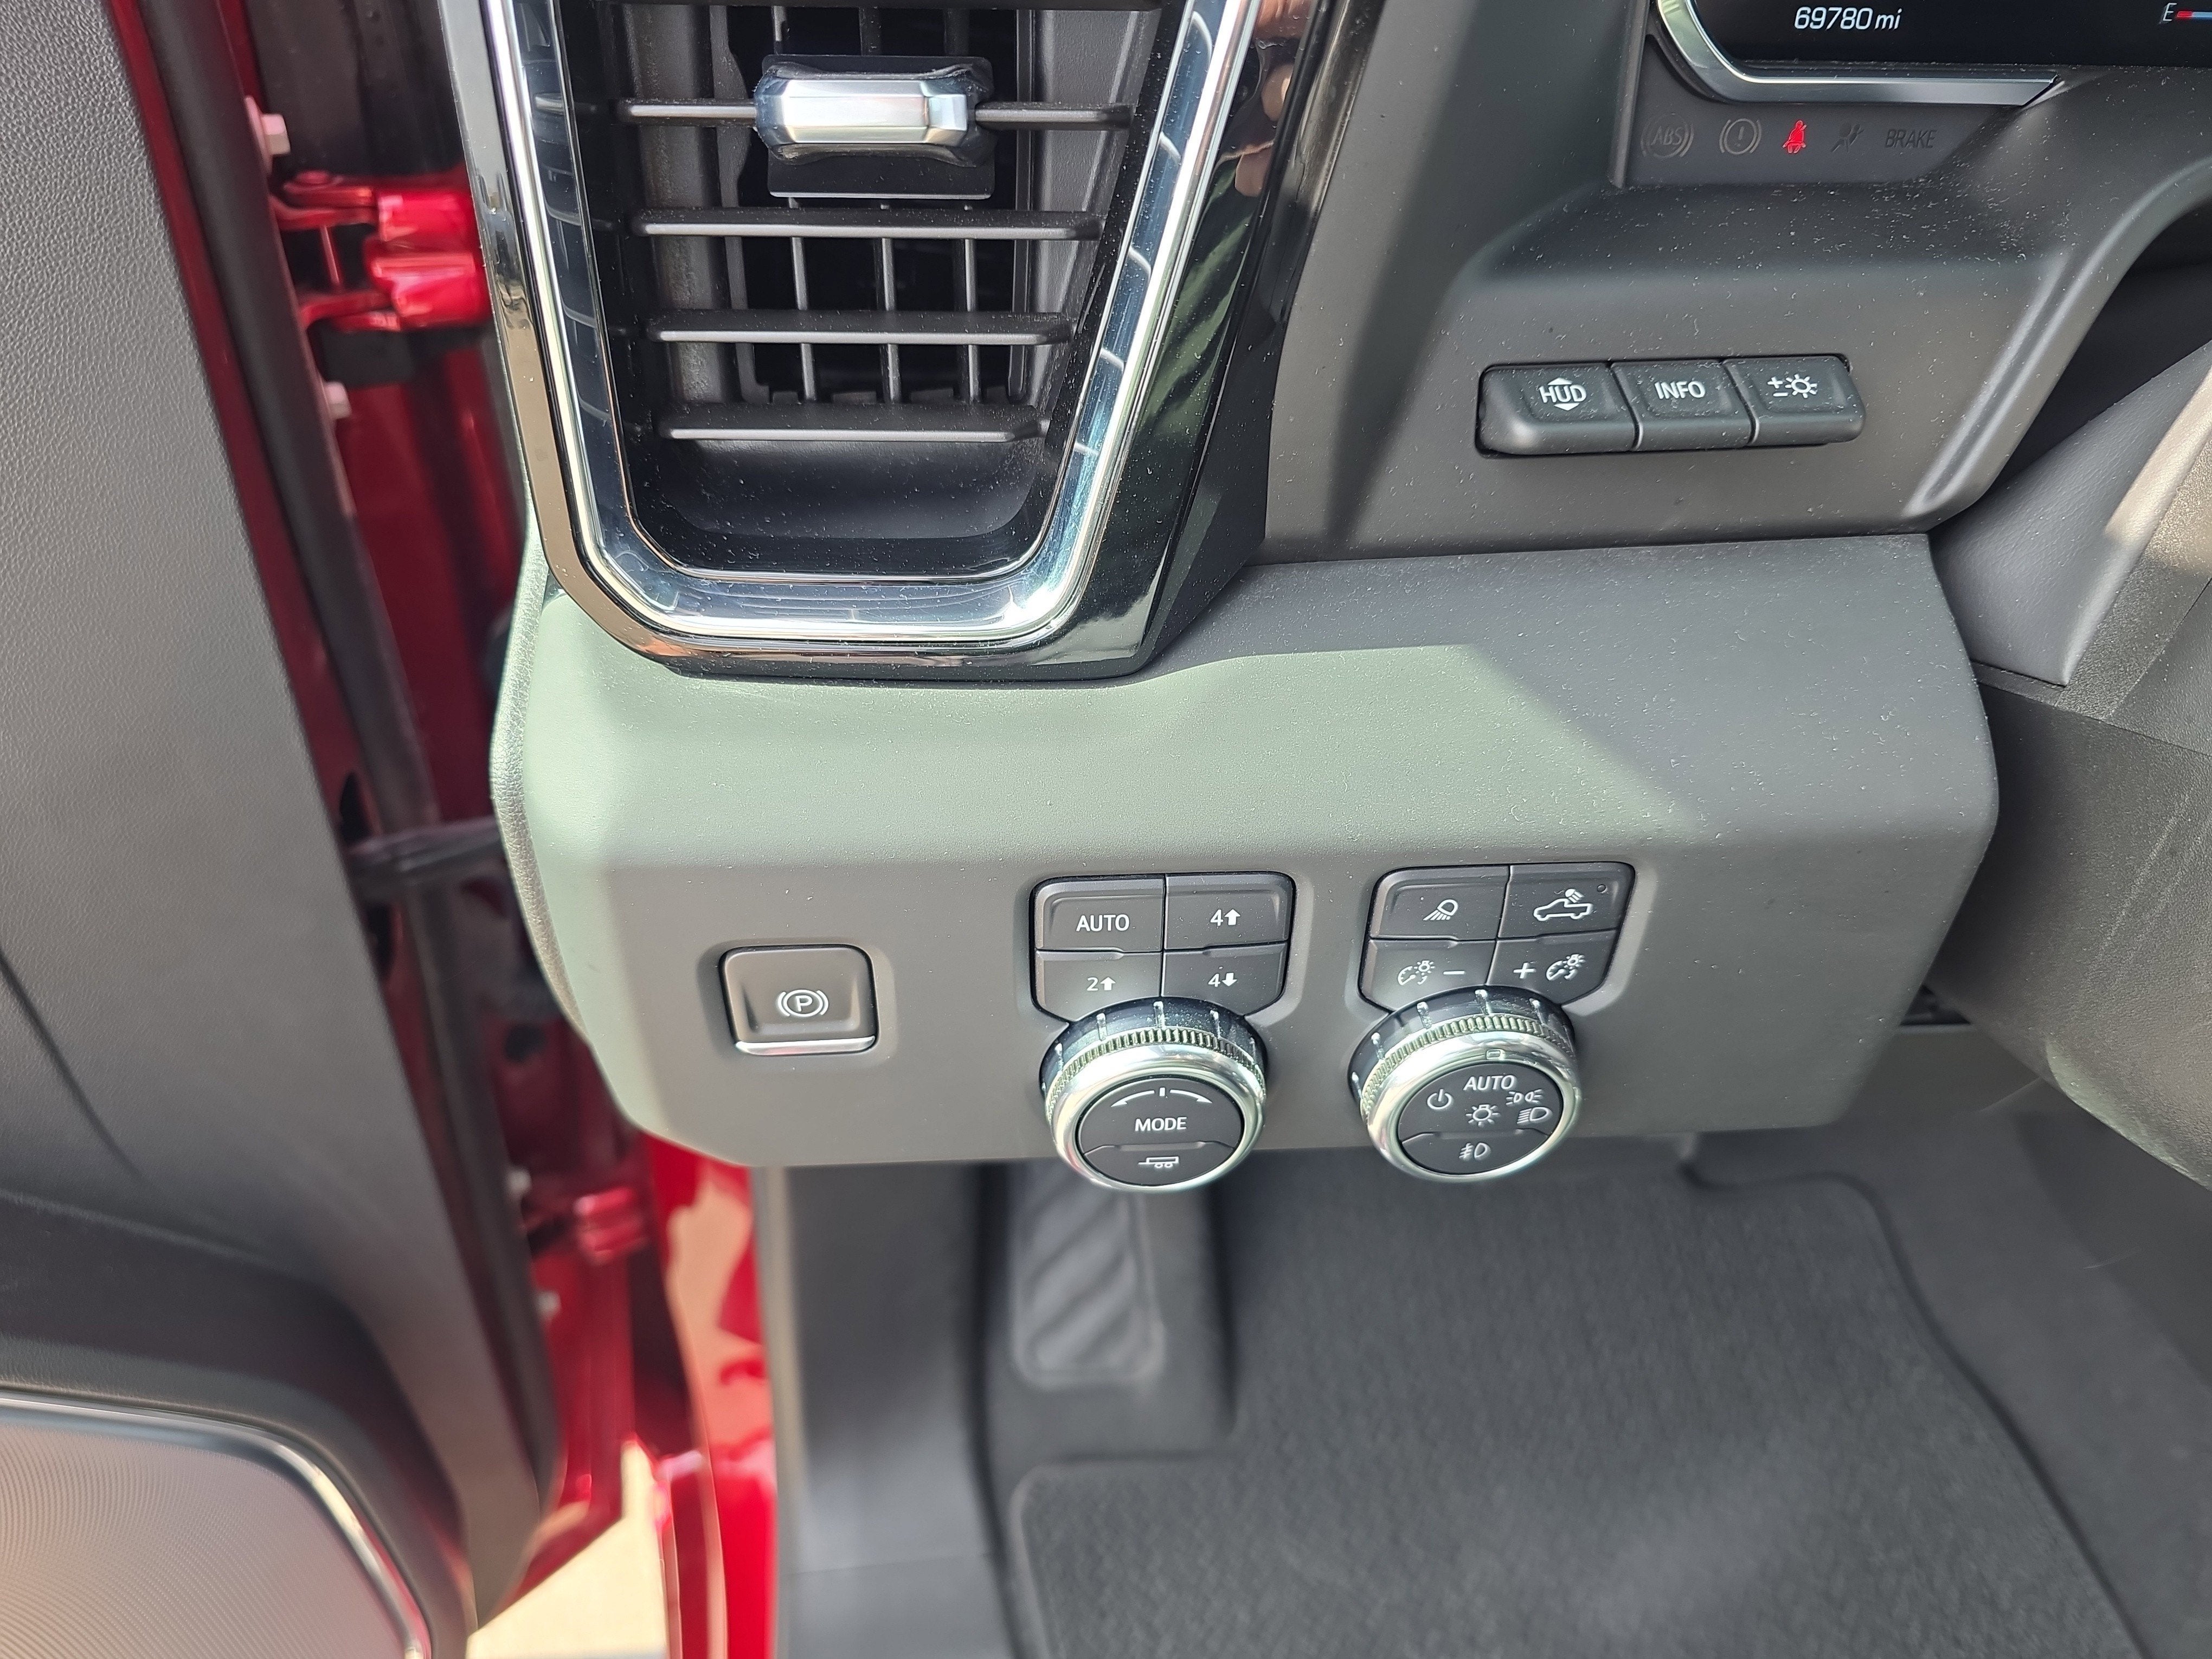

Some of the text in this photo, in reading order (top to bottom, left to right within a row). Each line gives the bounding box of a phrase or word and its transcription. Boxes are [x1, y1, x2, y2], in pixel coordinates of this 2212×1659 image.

[1794, 6, 1902, 30] 69780 mi
[2163, 2, 2177, 21] E
[1650, 126, 1683, 146] ABS
[1885, 128, 1938, 148] BRAKE
[1539, 384, 1587, 403] HUD
[1654, 380, 1706, 400] INFO
[1076, 914, 1130, 931] AUTO
[1210, 909, 1224, 927] 4
[1086, 976, 1099, 992] 2
[1208, 973, 1221, 988] 4
[795, 995, 813, 1012] P
[1463, 1074, 1516, 1091] AUTO
[1134, 1116, 1187, 1131] MODE
